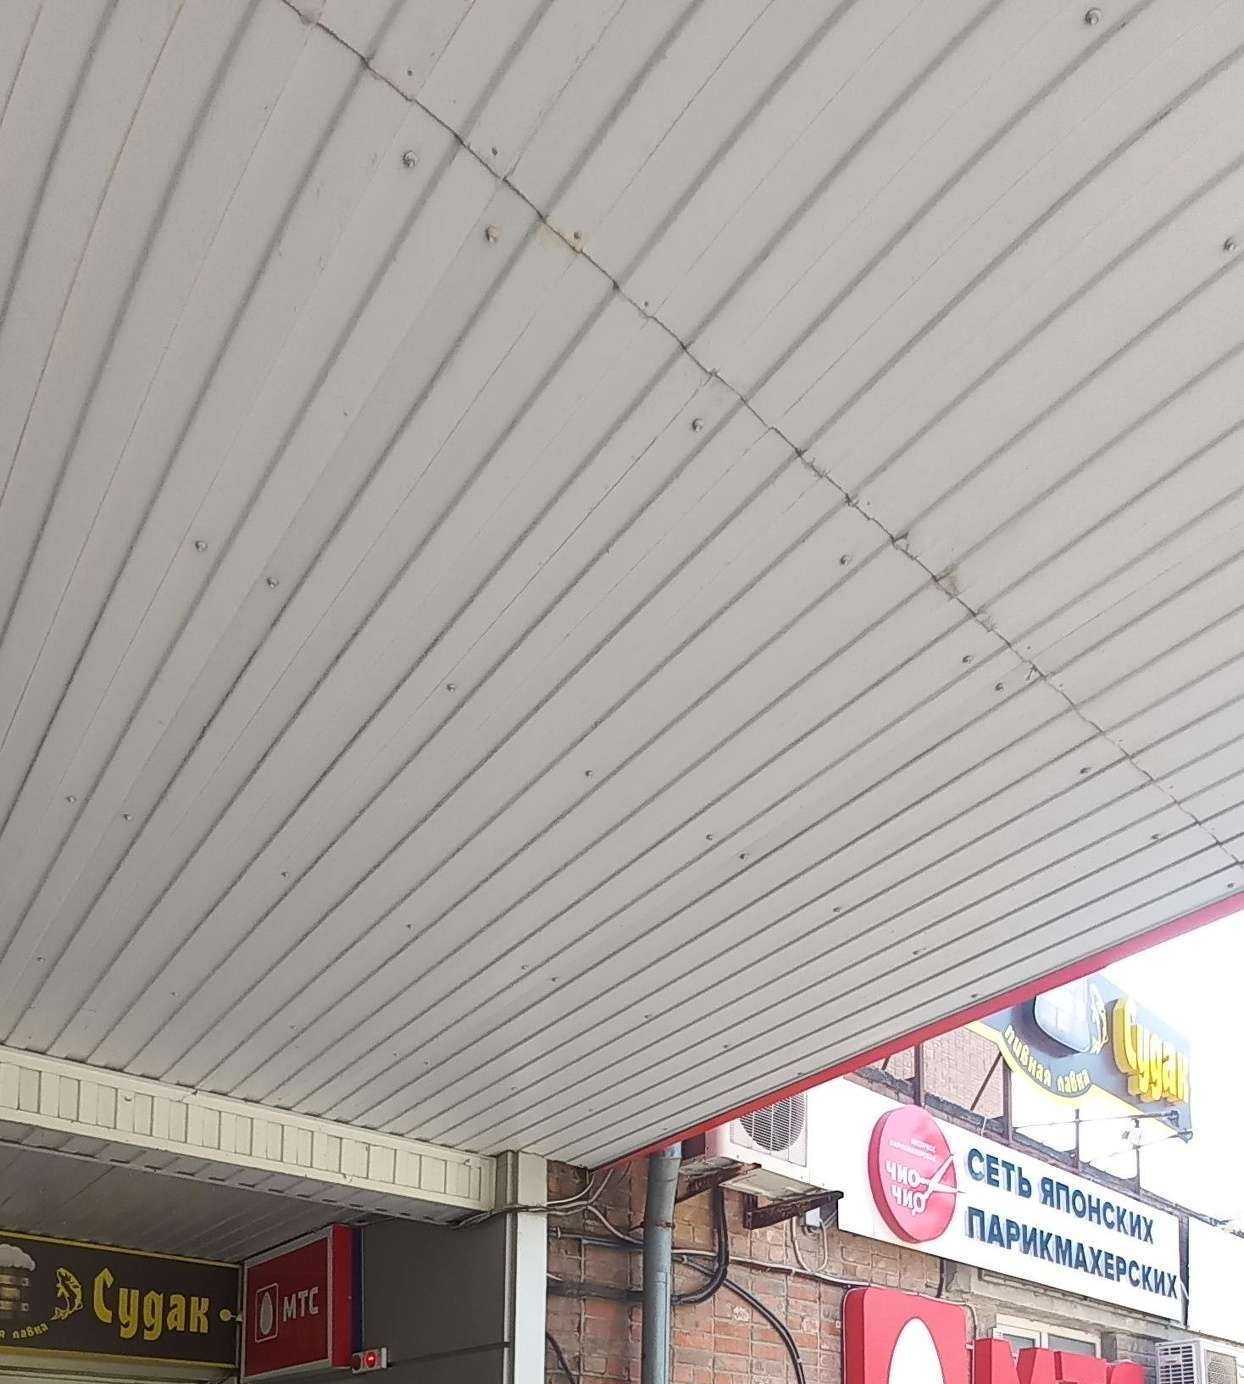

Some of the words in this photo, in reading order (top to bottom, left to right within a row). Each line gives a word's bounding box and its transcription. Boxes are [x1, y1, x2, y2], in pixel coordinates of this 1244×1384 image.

[966, 1148, 1032, 1199] СЕТЬ
[1039, 1176, 1154, 1244] ЯПОНСКИХ
[966, 1206, 1178, 1299] ПАРИКМАХЕРСКИХ
[93, 1267, 210, 1342] Судак
[283, 1286, 319, 1322] МТС
